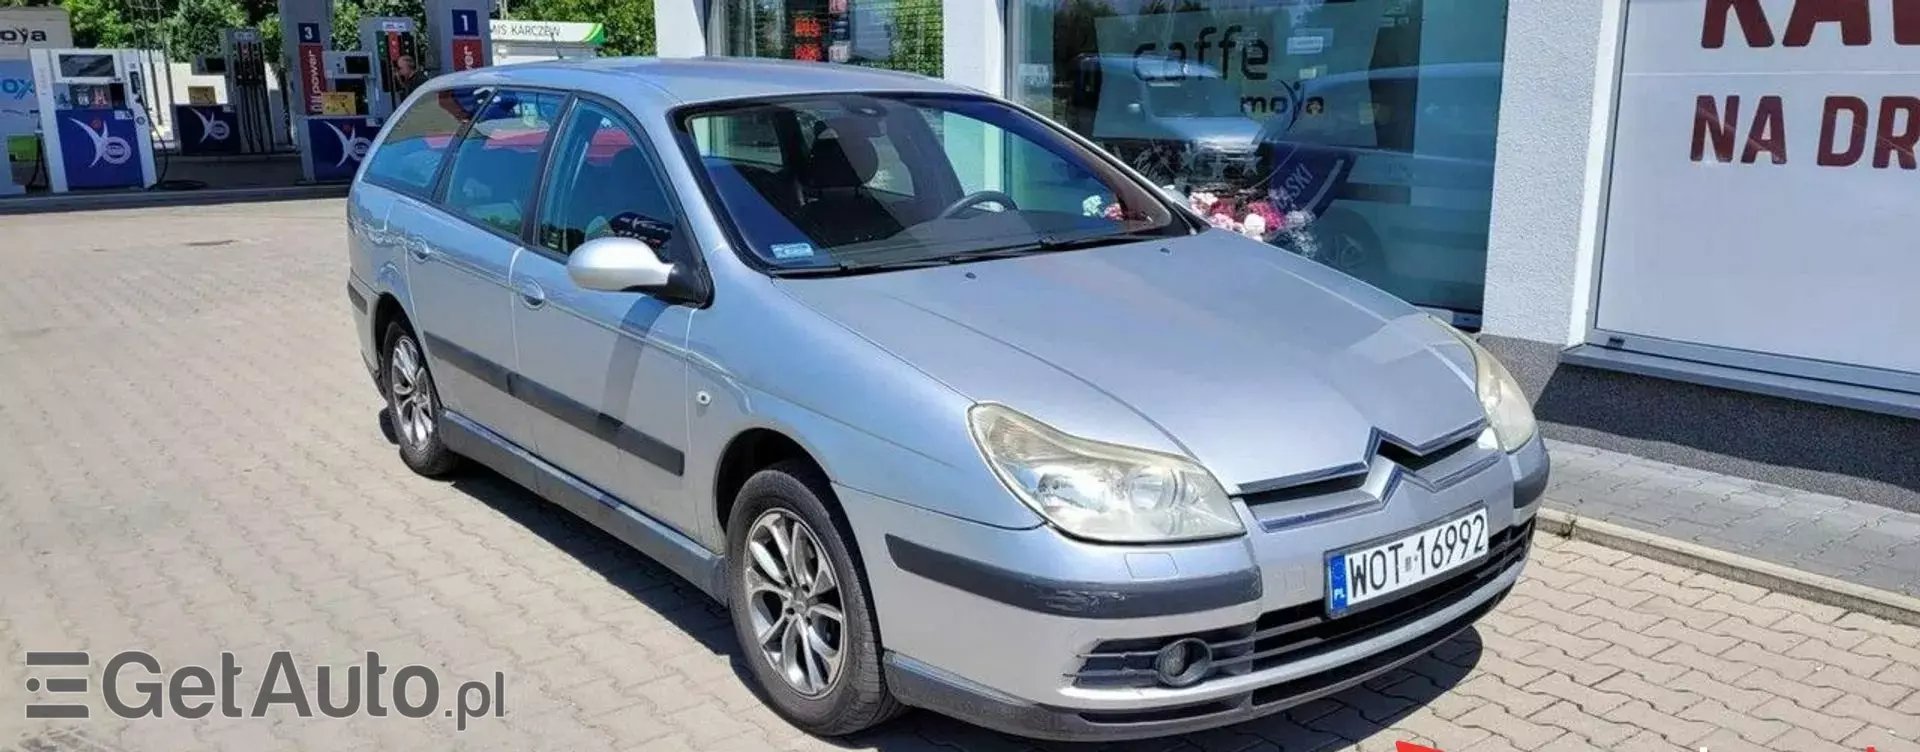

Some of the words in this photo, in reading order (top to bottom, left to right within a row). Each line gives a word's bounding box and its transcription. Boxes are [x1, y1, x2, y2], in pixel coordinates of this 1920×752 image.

[461, 14, 470, 32] 1
[511, 25, 561, 37] KARCZEW
[0, 27, 47, 46] oya
[304, 26, 313, 40] 3
[1690, 95, 1788, 164] NA
[1349, 543, 1405, 599] WOT
[1415, 515, 1485, 575] 16992
[1333, 588, 1346, 601] PL
